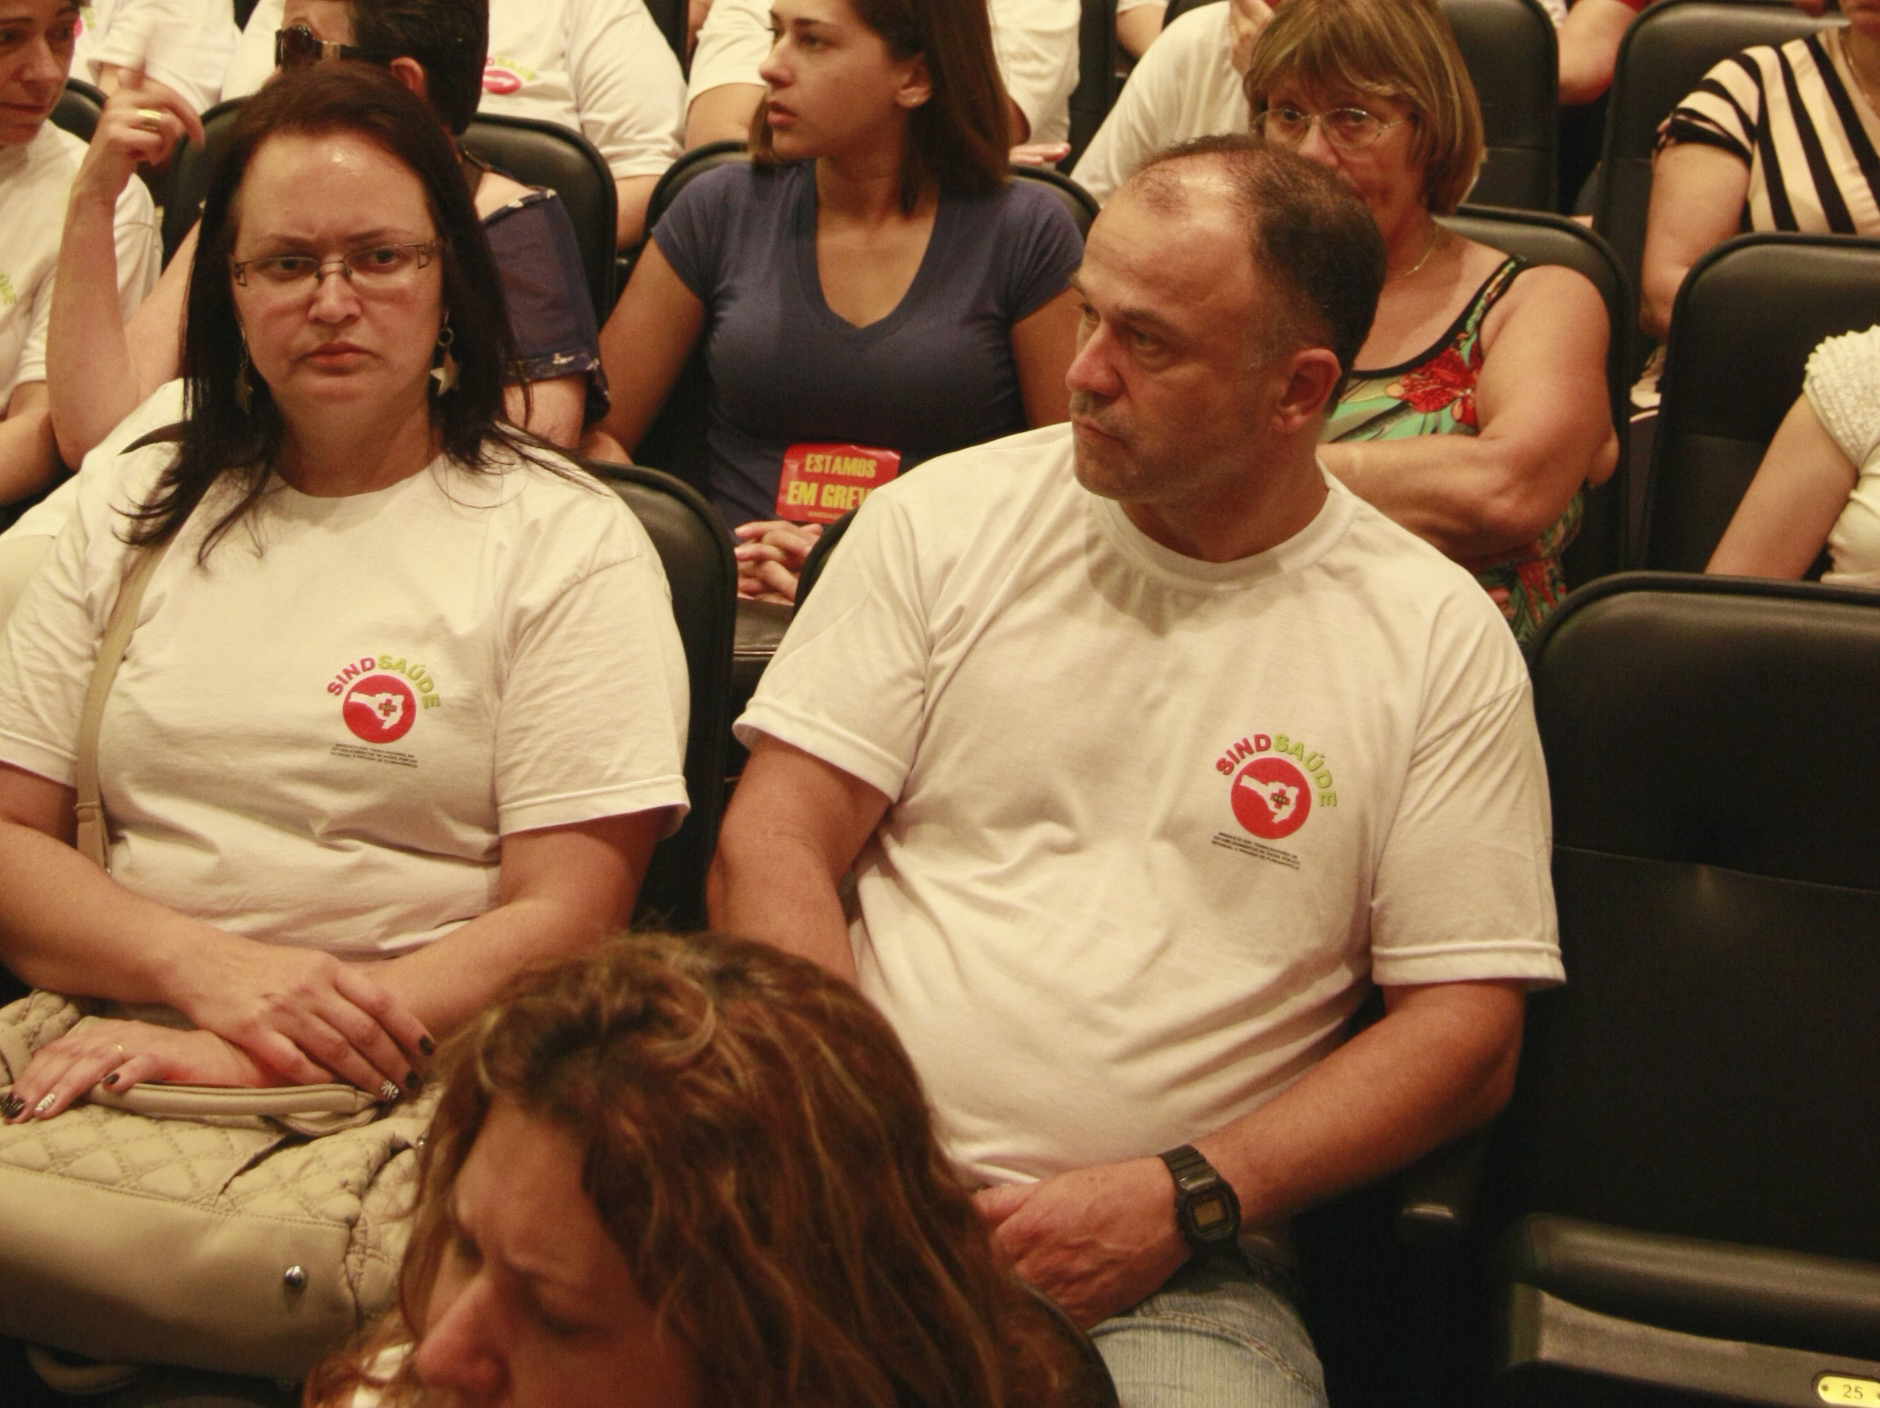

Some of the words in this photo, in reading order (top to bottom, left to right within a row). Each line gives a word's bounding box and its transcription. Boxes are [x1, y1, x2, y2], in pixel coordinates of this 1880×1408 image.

[804, 453, 877, 478] ESTAMOS
[786, 480, 818, 506] EM
[326, 654, 442, 710] SINDSAÚDE
[1215, 733, 1338, 808] SINDSAÚDE
[1842, 1383, 1864, 1400] 25
